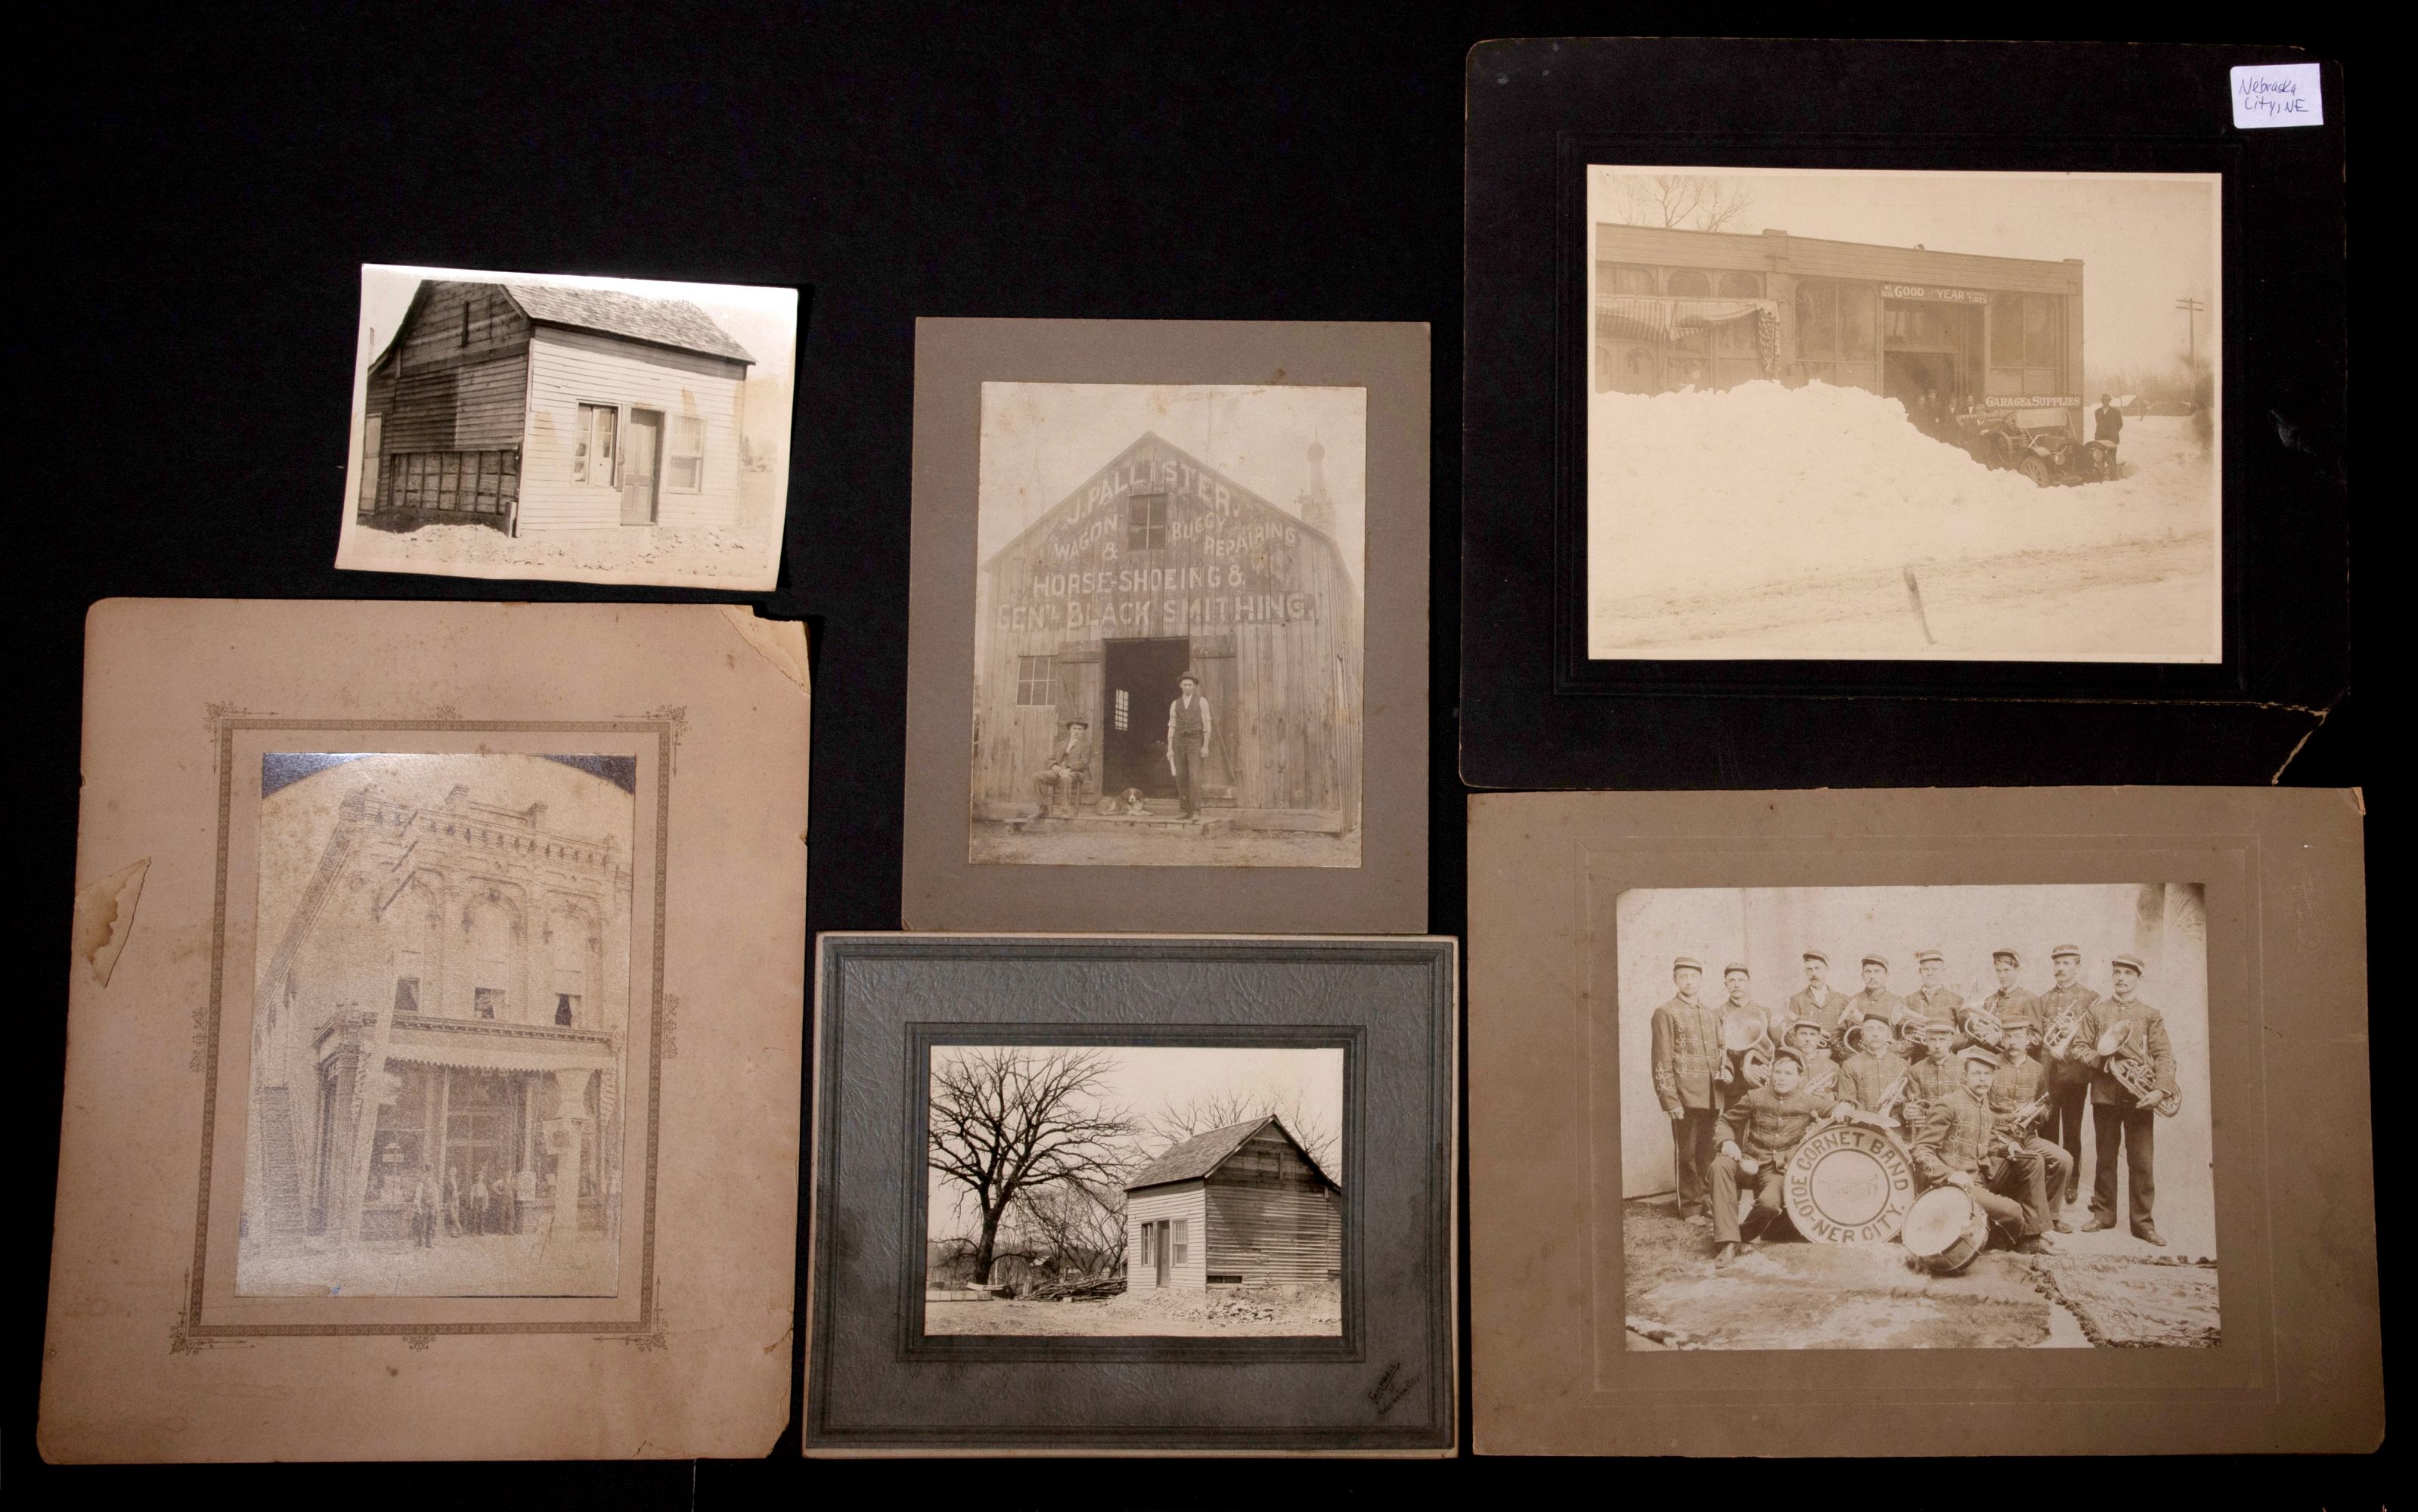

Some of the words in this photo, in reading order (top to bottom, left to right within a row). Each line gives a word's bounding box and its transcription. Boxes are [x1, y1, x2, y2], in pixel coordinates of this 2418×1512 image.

[2239, 76, 2296, 95] Nebraska
[2284, 99, 2309, 113] NE
[1895, 285, 1924, 298] GOOD
[1936, 289, 1965, 301] YEAR
[1986, 396, 2027, 407] GARAGE
[2032, 396, 2081, 406] SUPPLIES
[1053, 513, 1118, 561] WAGON
[1171, 511, 1226, 541] BUGGY
[1101, 541, 1118, 561] &
[1204, 522, 1296, 557] REPAIRING
[1066, 600, 1151, 627] BLACK
[1796, 1131, 1865, 1172] CORNET
[1869, 1138, 1909, 1191] BAND
